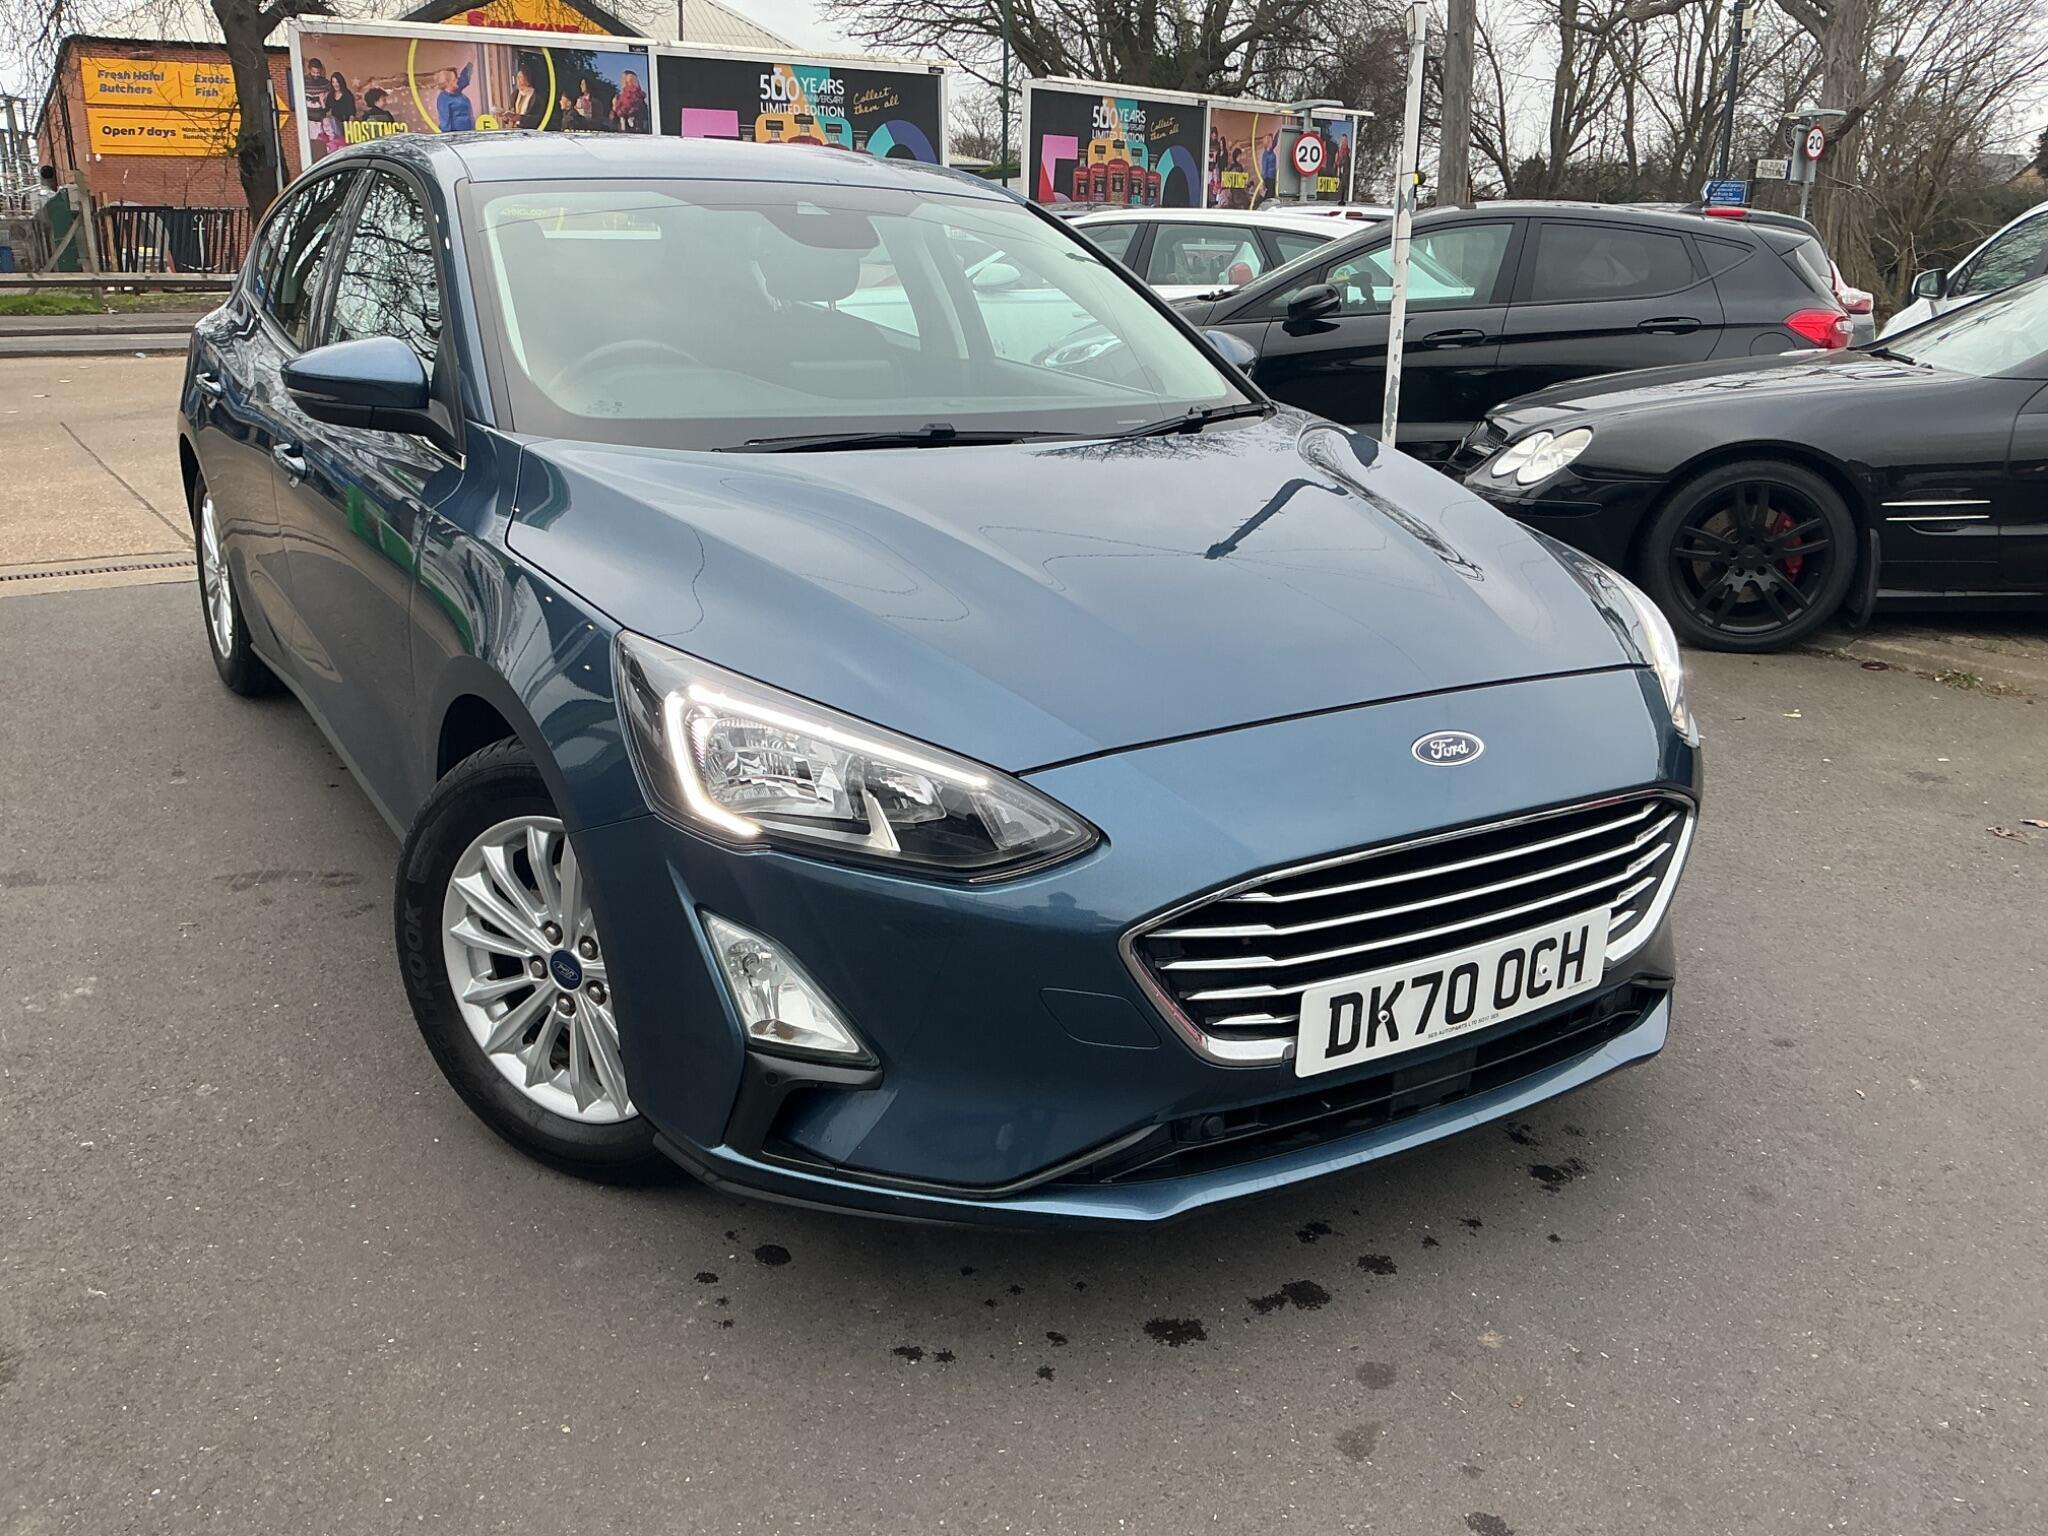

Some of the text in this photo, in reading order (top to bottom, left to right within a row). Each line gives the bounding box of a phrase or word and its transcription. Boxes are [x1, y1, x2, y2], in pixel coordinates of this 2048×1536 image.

[97, 70, 164, 82] Fresh Halal
[194, 74, 231, 85] Exotic
[99, 84, 153, 95] Butchers
[195, 88, 219, 97] Fish
[760, 71, 845, 101] 500 YEARS
[853, 86, 892, 105] Collect
[760, 102, 845, 118] LIMITED EDITION
[853, 94, 900, 115] them all
[1119, 108, 1147, 124] YEARS
[102, 126, 177, 139] Open 7 days
[1808, 136, 1823, 150] 20
[1298, 146, 1321, 163] 20
[1430, 738, 1470, 760] Ford
[1325, 925, 1589, 1059] DK70 OCH
